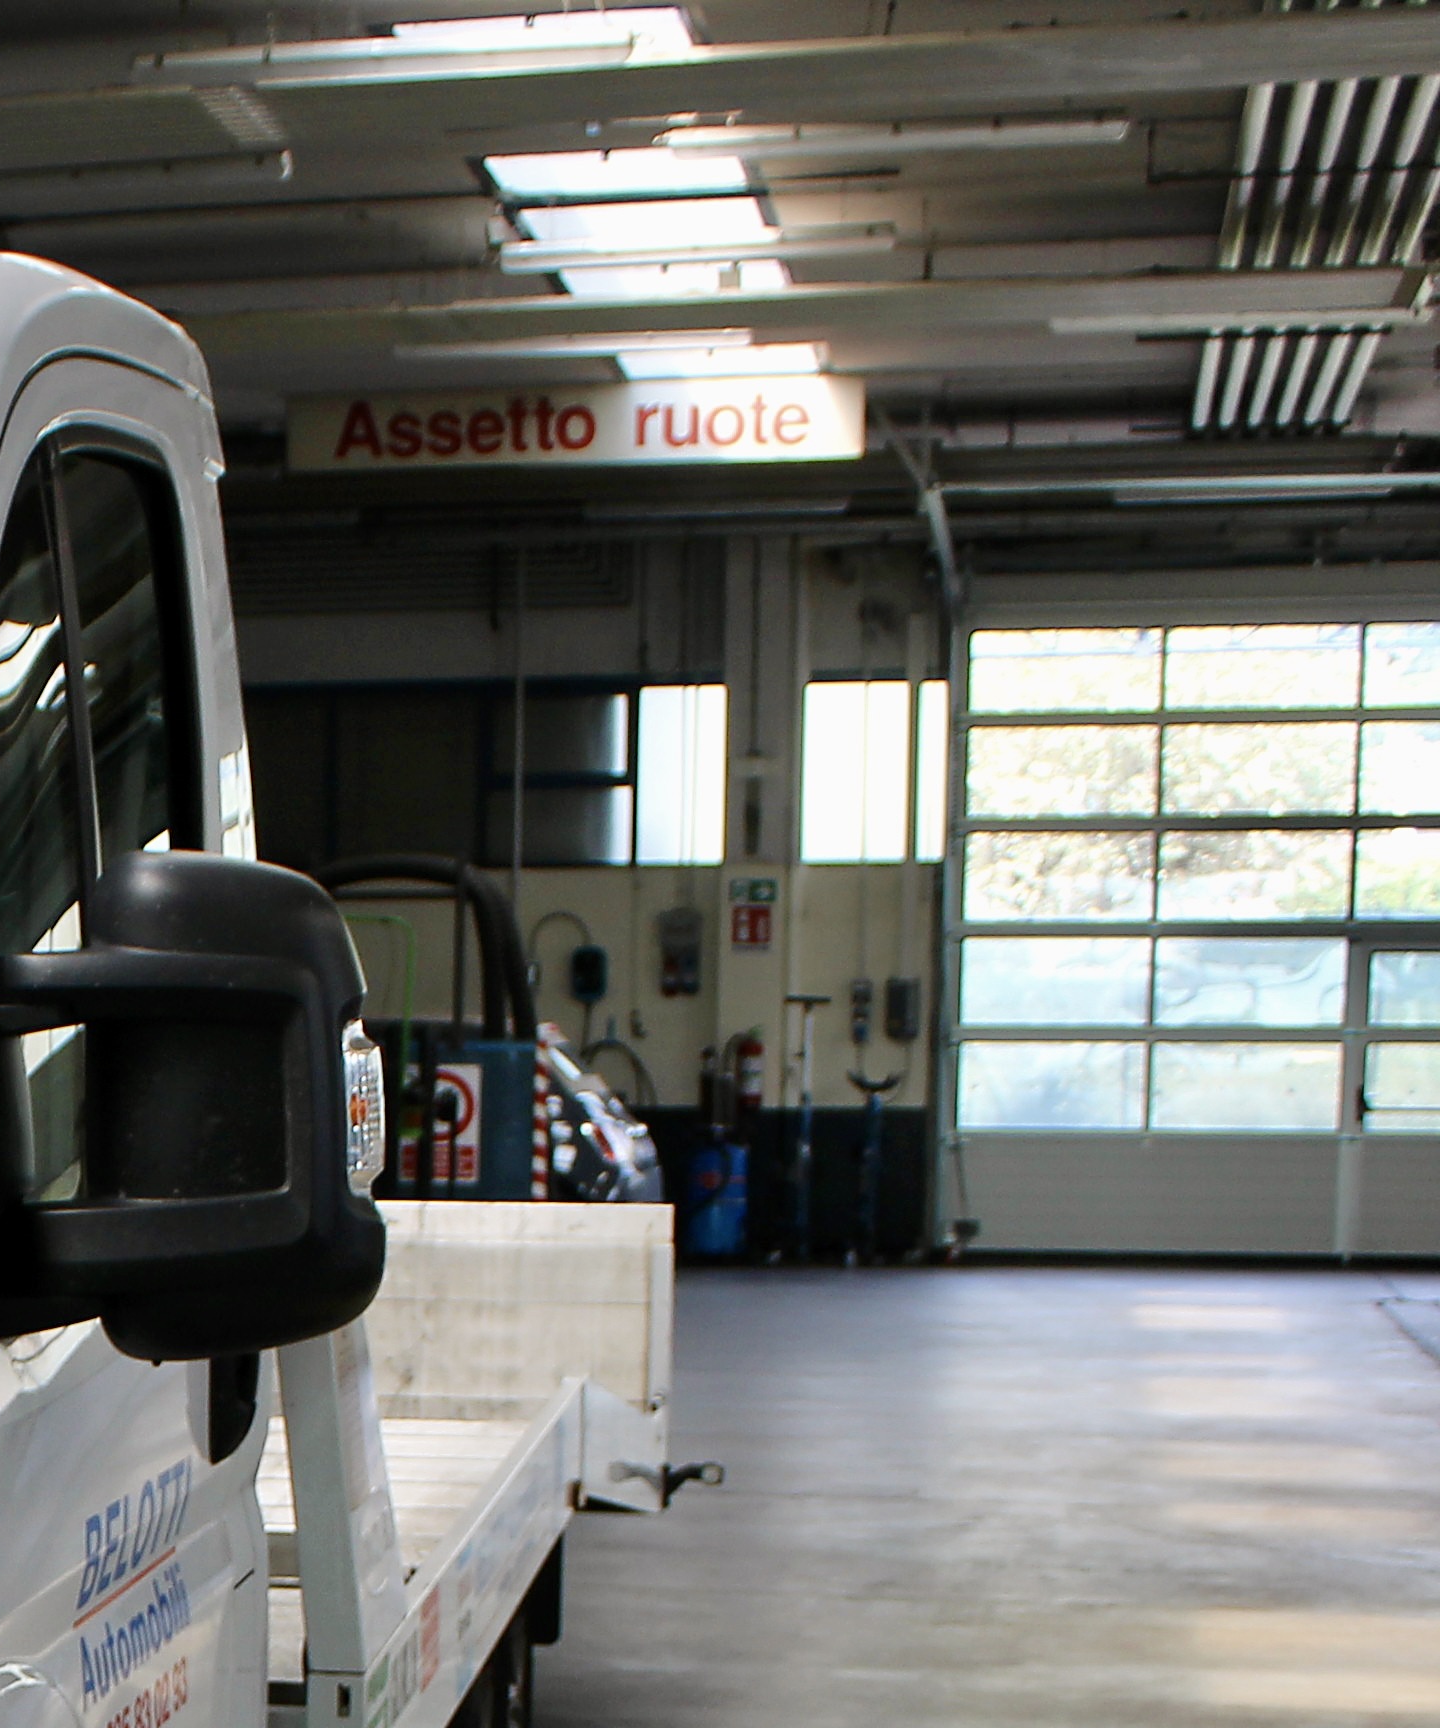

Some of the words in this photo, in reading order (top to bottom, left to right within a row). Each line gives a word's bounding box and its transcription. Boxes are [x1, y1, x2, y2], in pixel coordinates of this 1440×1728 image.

[335, 395, 596, 458] Assetto
[634, 393, 810, 447] ruote
[77, 1455, 191, 1610] BELOTTI
[80, 1562, 190, 1713] Automobili
